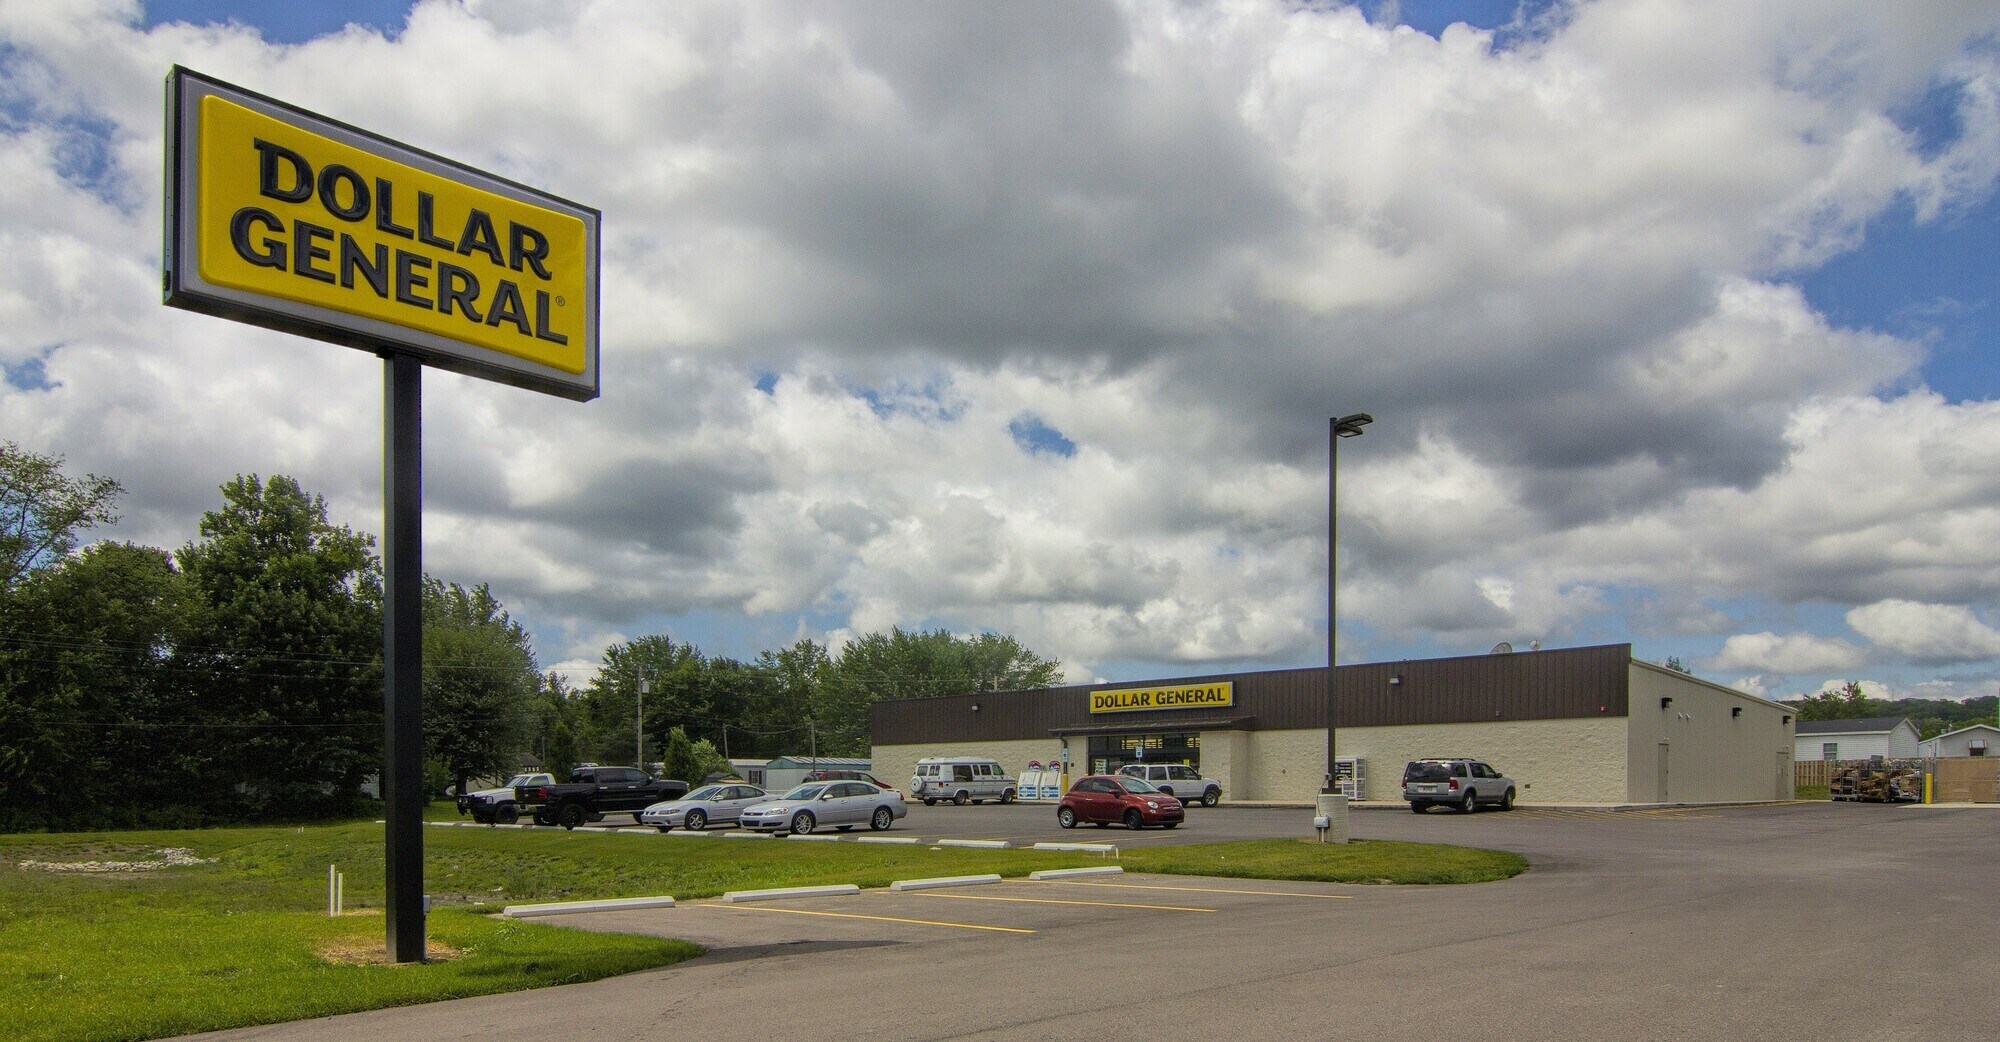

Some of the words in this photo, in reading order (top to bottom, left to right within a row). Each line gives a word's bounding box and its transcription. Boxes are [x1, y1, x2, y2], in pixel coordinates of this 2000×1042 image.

[253, 136, 553, 281] DOLLAR
[1094, 692, 1150, 709] DOLLAR
[1155, 687, 1226, 705] GENERAL
